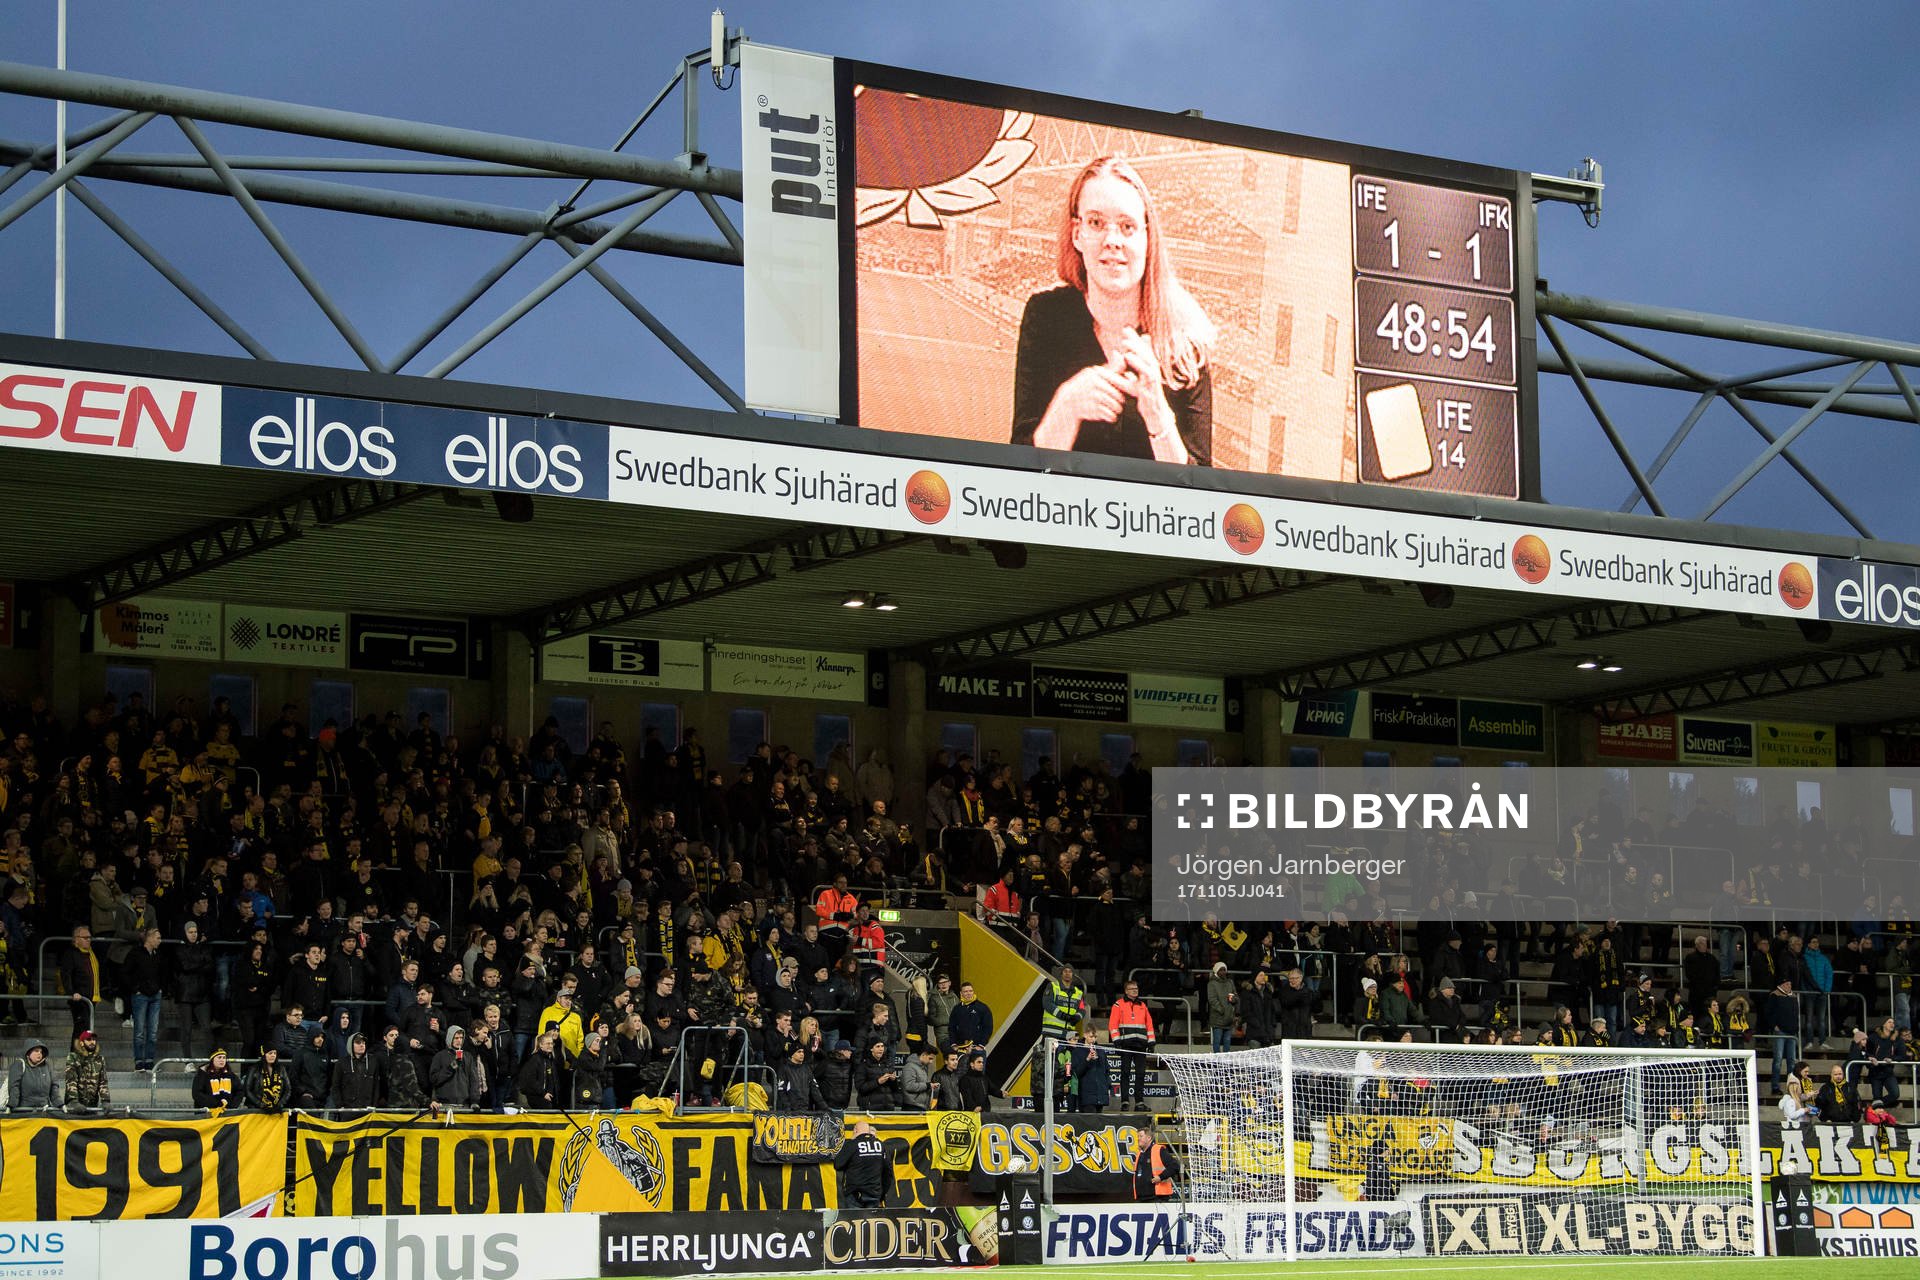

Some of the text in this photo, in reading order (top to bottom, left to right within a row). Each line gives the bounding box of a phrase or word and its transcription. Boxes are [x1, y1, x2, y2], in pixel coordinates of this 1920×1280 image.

[758, 108, 836, 220] put
[823, 116, 836, 198] interiör
[1357, 182, 1509, 230] IFE IFK
[1384, 218, 1400, 269] 1
[1465, 232, 1482, 281] 1
[1376, 302, 1497, 363] 48:54
[0, 373, 197, 453] SEN
[249, 396, 397, 477] ellos
[1436, 398, 1473, 432] IFE
[444, 416, 584, 493] ellos
[1437, 439, 1467, 470] 14
[615, 449, 898, 510] Swedbank Sjuhärad
[961, 486, 1216, 540] Swedbank Sjuhärad
[1274, 518, 1506, 571] Swedbank Sjuhärad
[1558, 549, 1772, 598] Swedbank Sjuhärad
[1835, 564, 1920, 626] ellos
[116, 606, 169, 622] Kimmos
[266, 622, 341, 643] LONDRÉ
[272, 642, 336, 654] TEXTILES
[938, 675, 1000, 697] MAKE
[1305, 709, 1345, 726] KPMG
[1468, 716, 1537, 738] Assemblin
[1607, 722, 1664, 740] PEAB
[753, 1114, 813, 1148] YOUTH
[776, 1138, 819, 1155] FANATICS
[858, 1141, 882, 1154] SLO
[1331, 1116, 1396, 1141] UNGA
[29, 1123, 241, 1222] 1991
[304, 1136, 556, 1217] YELLOW
[189, 1219, 519, 1280] Borohus
[607, 1231, 812, 1270] HERRLJUNGA
[824, 1216, 953, 1264] CIDER
[1047, 1212, 1227, 1258] FRISTADS
[1244, 1210, 1416, 1254] FRISTADS
[38, 1268, 64, 1276] 1992
